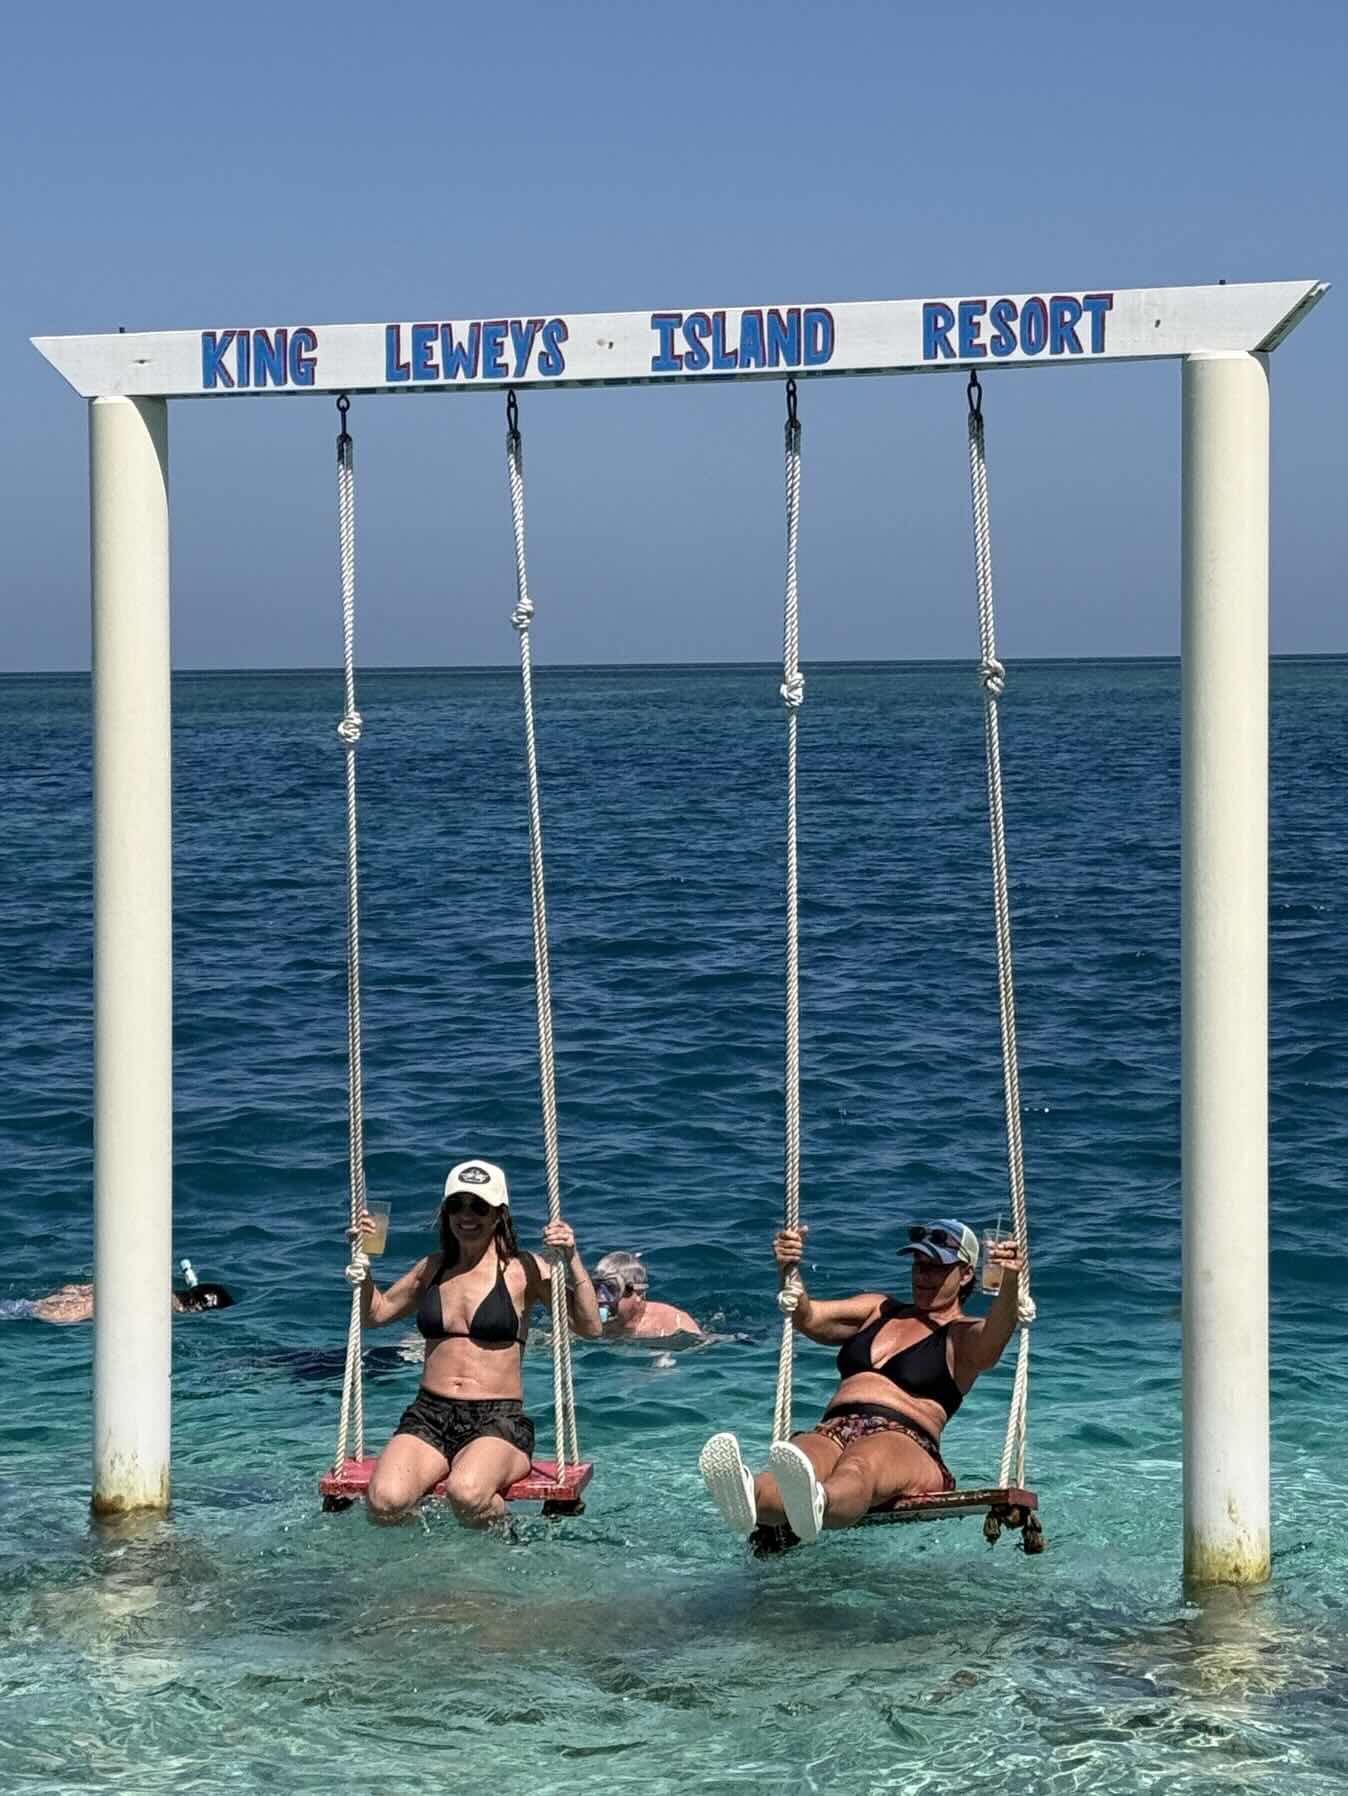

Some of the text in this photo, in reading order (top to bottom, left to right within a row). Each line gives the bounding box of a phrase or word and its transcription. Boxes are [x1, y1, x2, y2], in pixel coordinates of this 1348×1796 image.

[202, 327, 318, 389] KING
[650, 308, 834, 372] ISLAND
[922, 293, 1113, 361] RESORT
